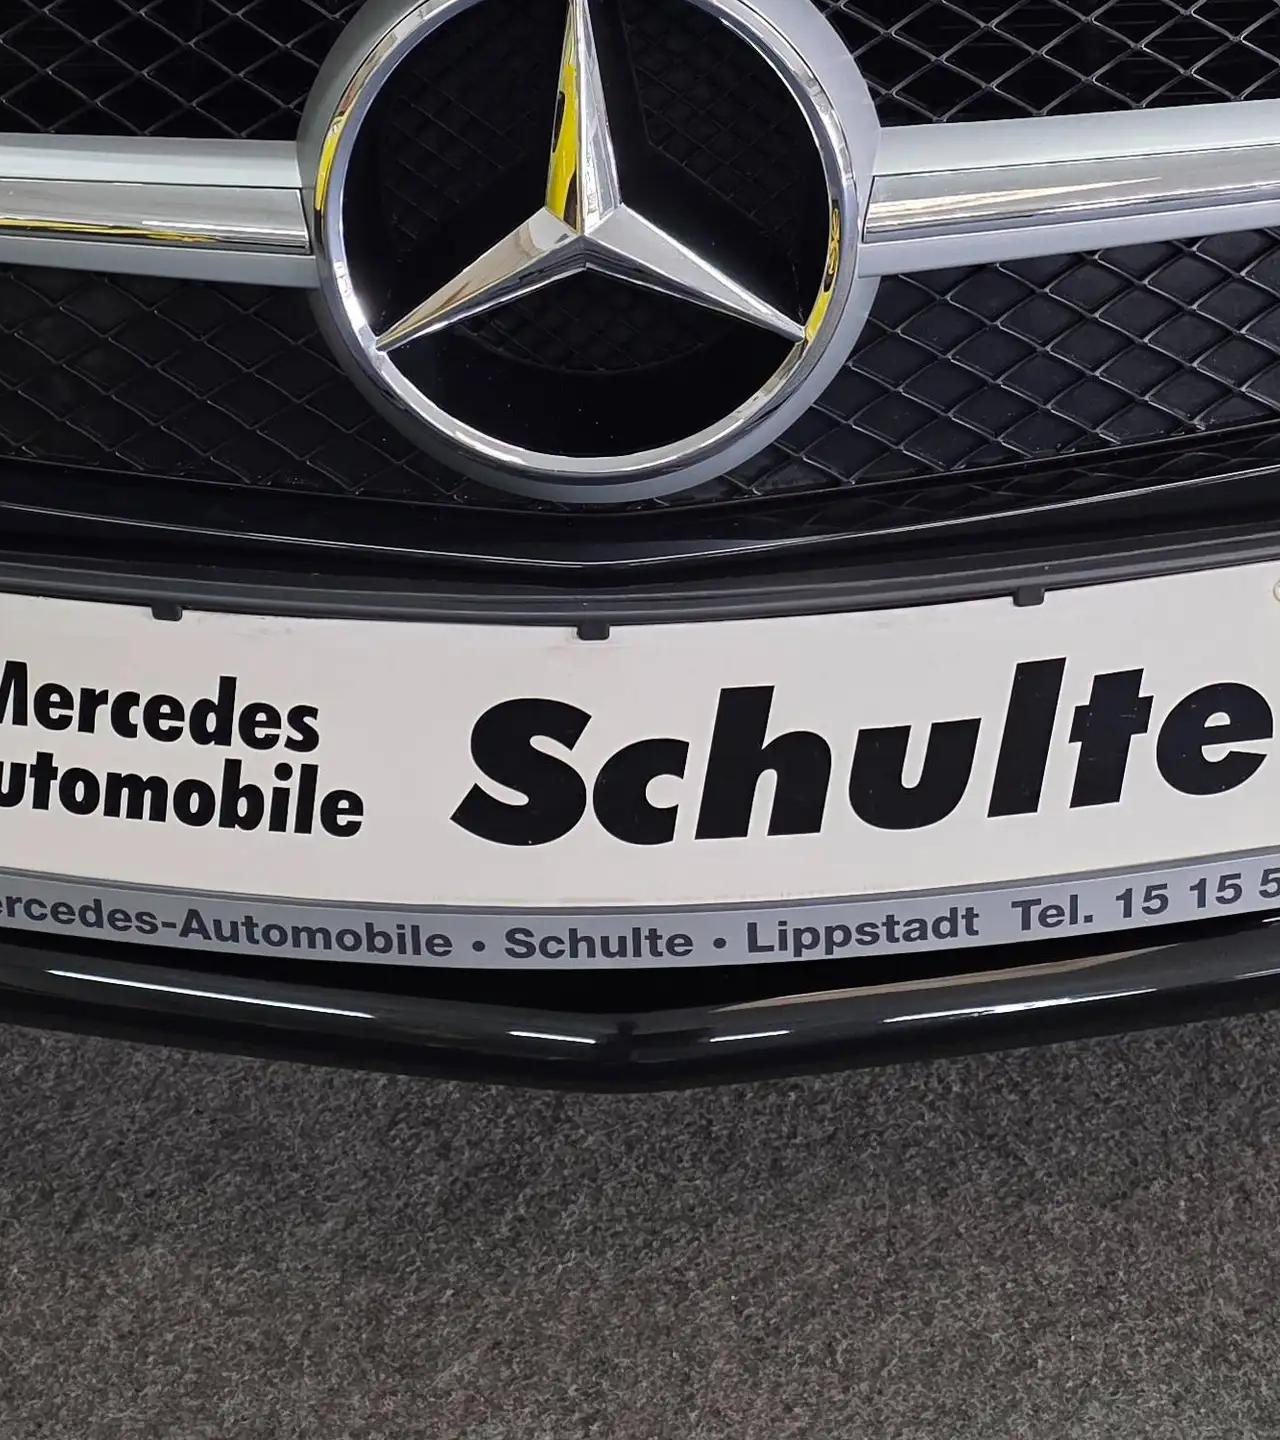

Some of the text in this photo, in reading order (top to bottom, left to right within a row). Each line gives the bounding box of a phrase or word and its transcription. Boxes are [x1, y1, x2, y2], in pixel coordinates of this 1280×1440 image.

[449, 656, 1274, 847] Schulte
[504, 926, 694, 959] Schulte
[747, 906, 981, 958] Lippstadt
[1011, 894, 1093, 931] Tel.
[1115, 883, 1169, 919] 15
[1189, 872, 1243, 909] 15
